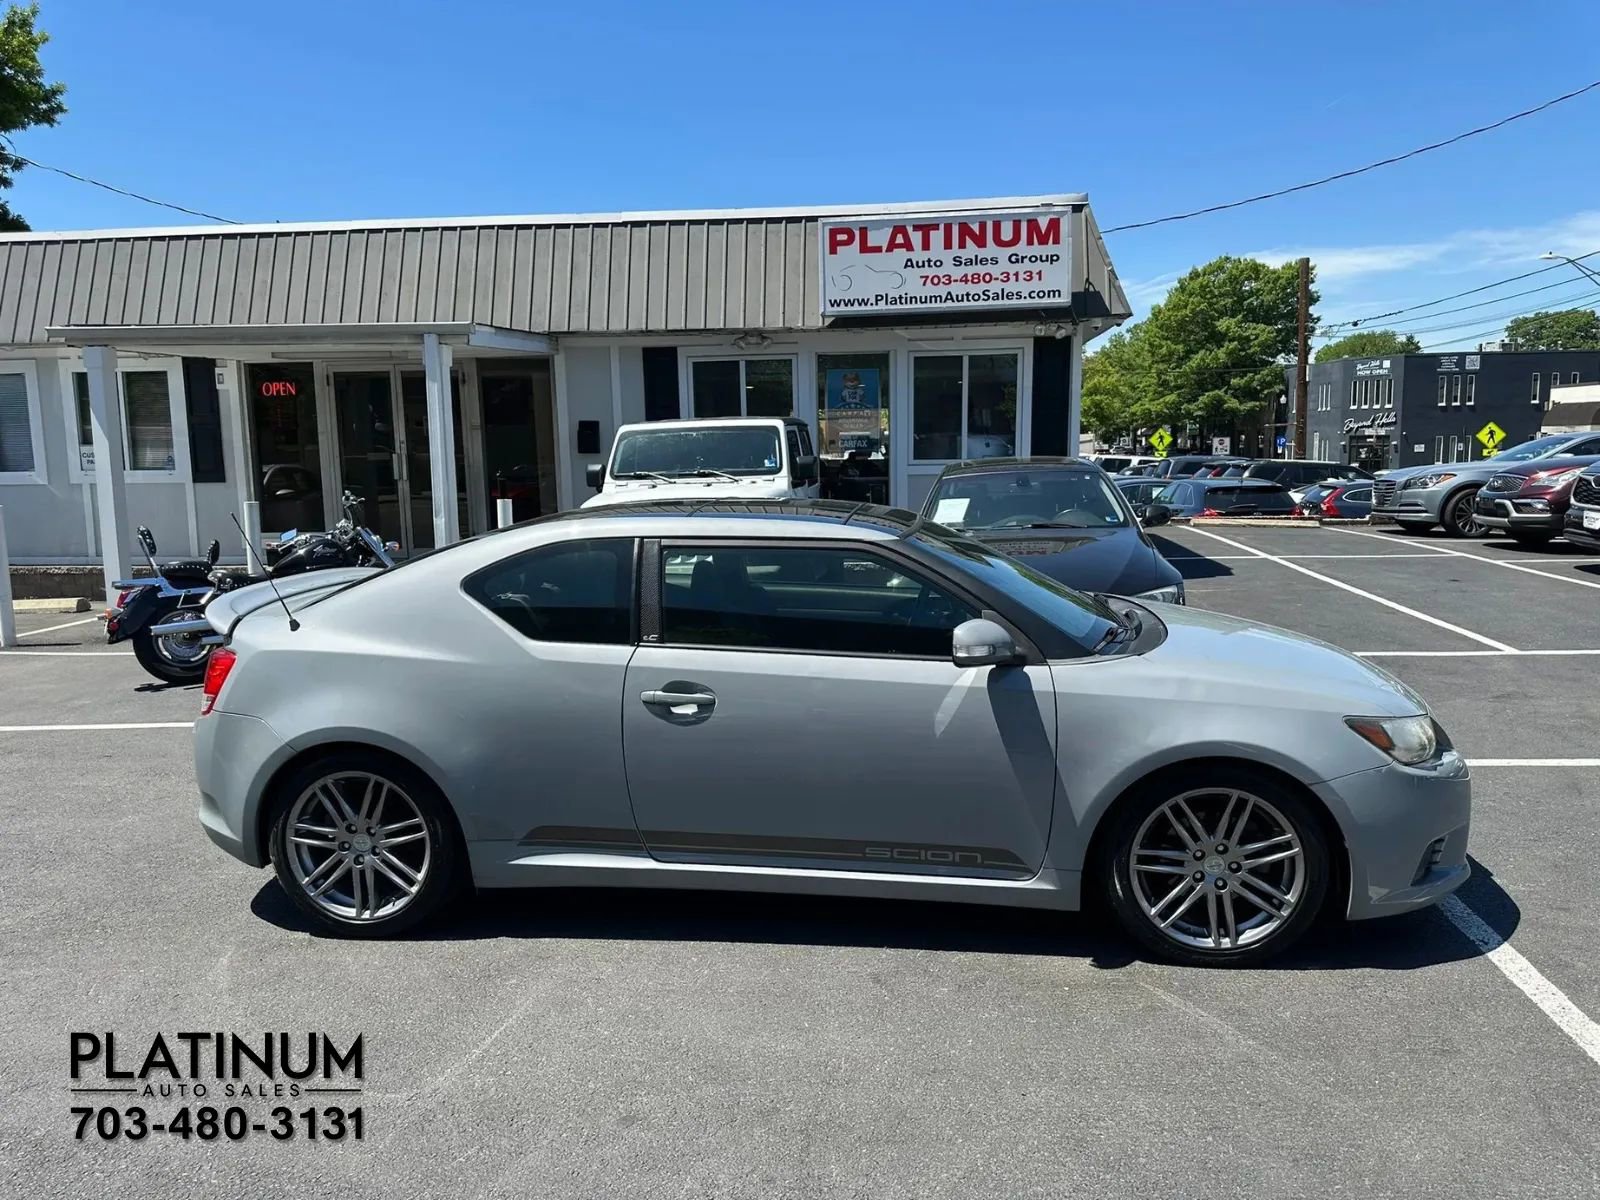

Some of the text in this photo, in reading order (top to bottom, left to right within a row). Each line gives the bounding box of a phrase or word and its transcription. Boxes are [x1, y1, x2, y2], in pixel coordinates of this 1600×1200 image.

[828, 217, 1062, 255] PLATINUM
[903, 252, 1061, 270] Auto Sales Group
[919, 270, 1044, 287] 703-480-3131
[828, 288, 1062, 308] www.PlatinumAutoSales.com
[262, 382, 296, 396] OPEN
[1343, 415, 1375, 432] Beyond
[838, 439, 868, 448] CARFAX
[865, 847, 982, 864] SCION
